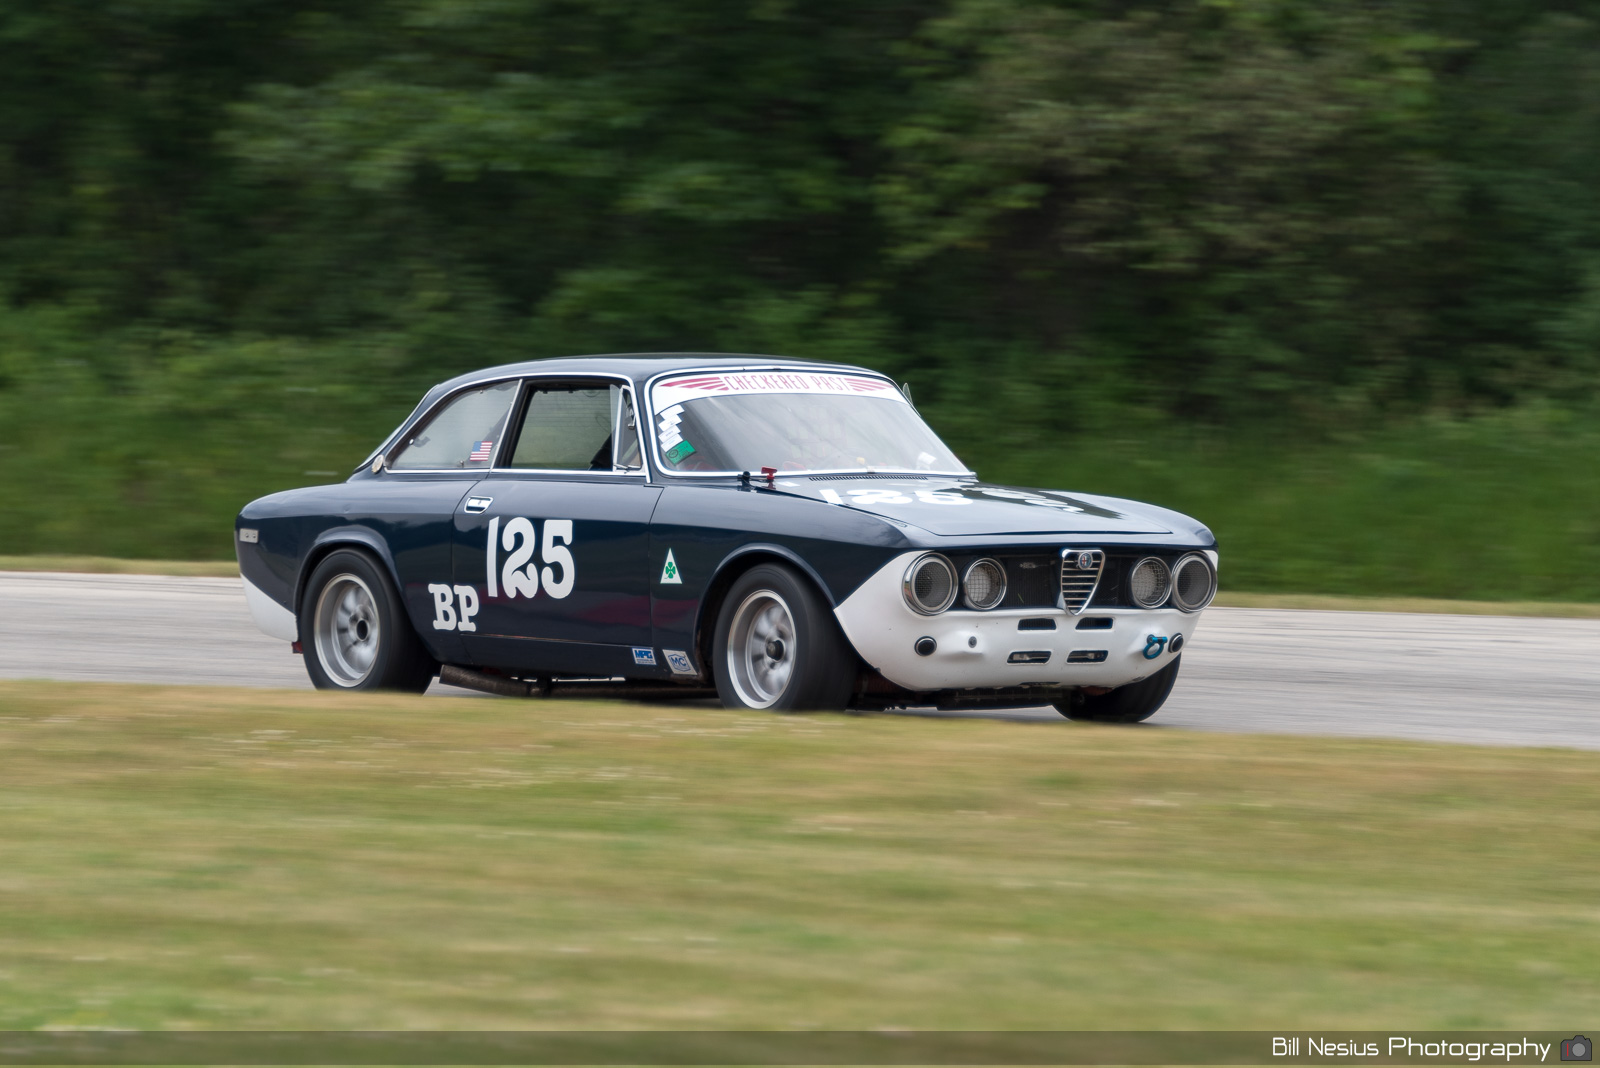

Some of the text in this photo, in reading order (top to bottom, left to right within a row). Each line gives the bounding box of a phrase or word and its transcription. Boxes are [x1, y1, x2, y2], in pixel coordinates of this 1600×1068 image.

[724, 375, 850, 391] CHECKERED PAST
[819, 489, 973, 506] 125
[487, 516, 575, 599] 125
[428, 583, 480, 632] BP
